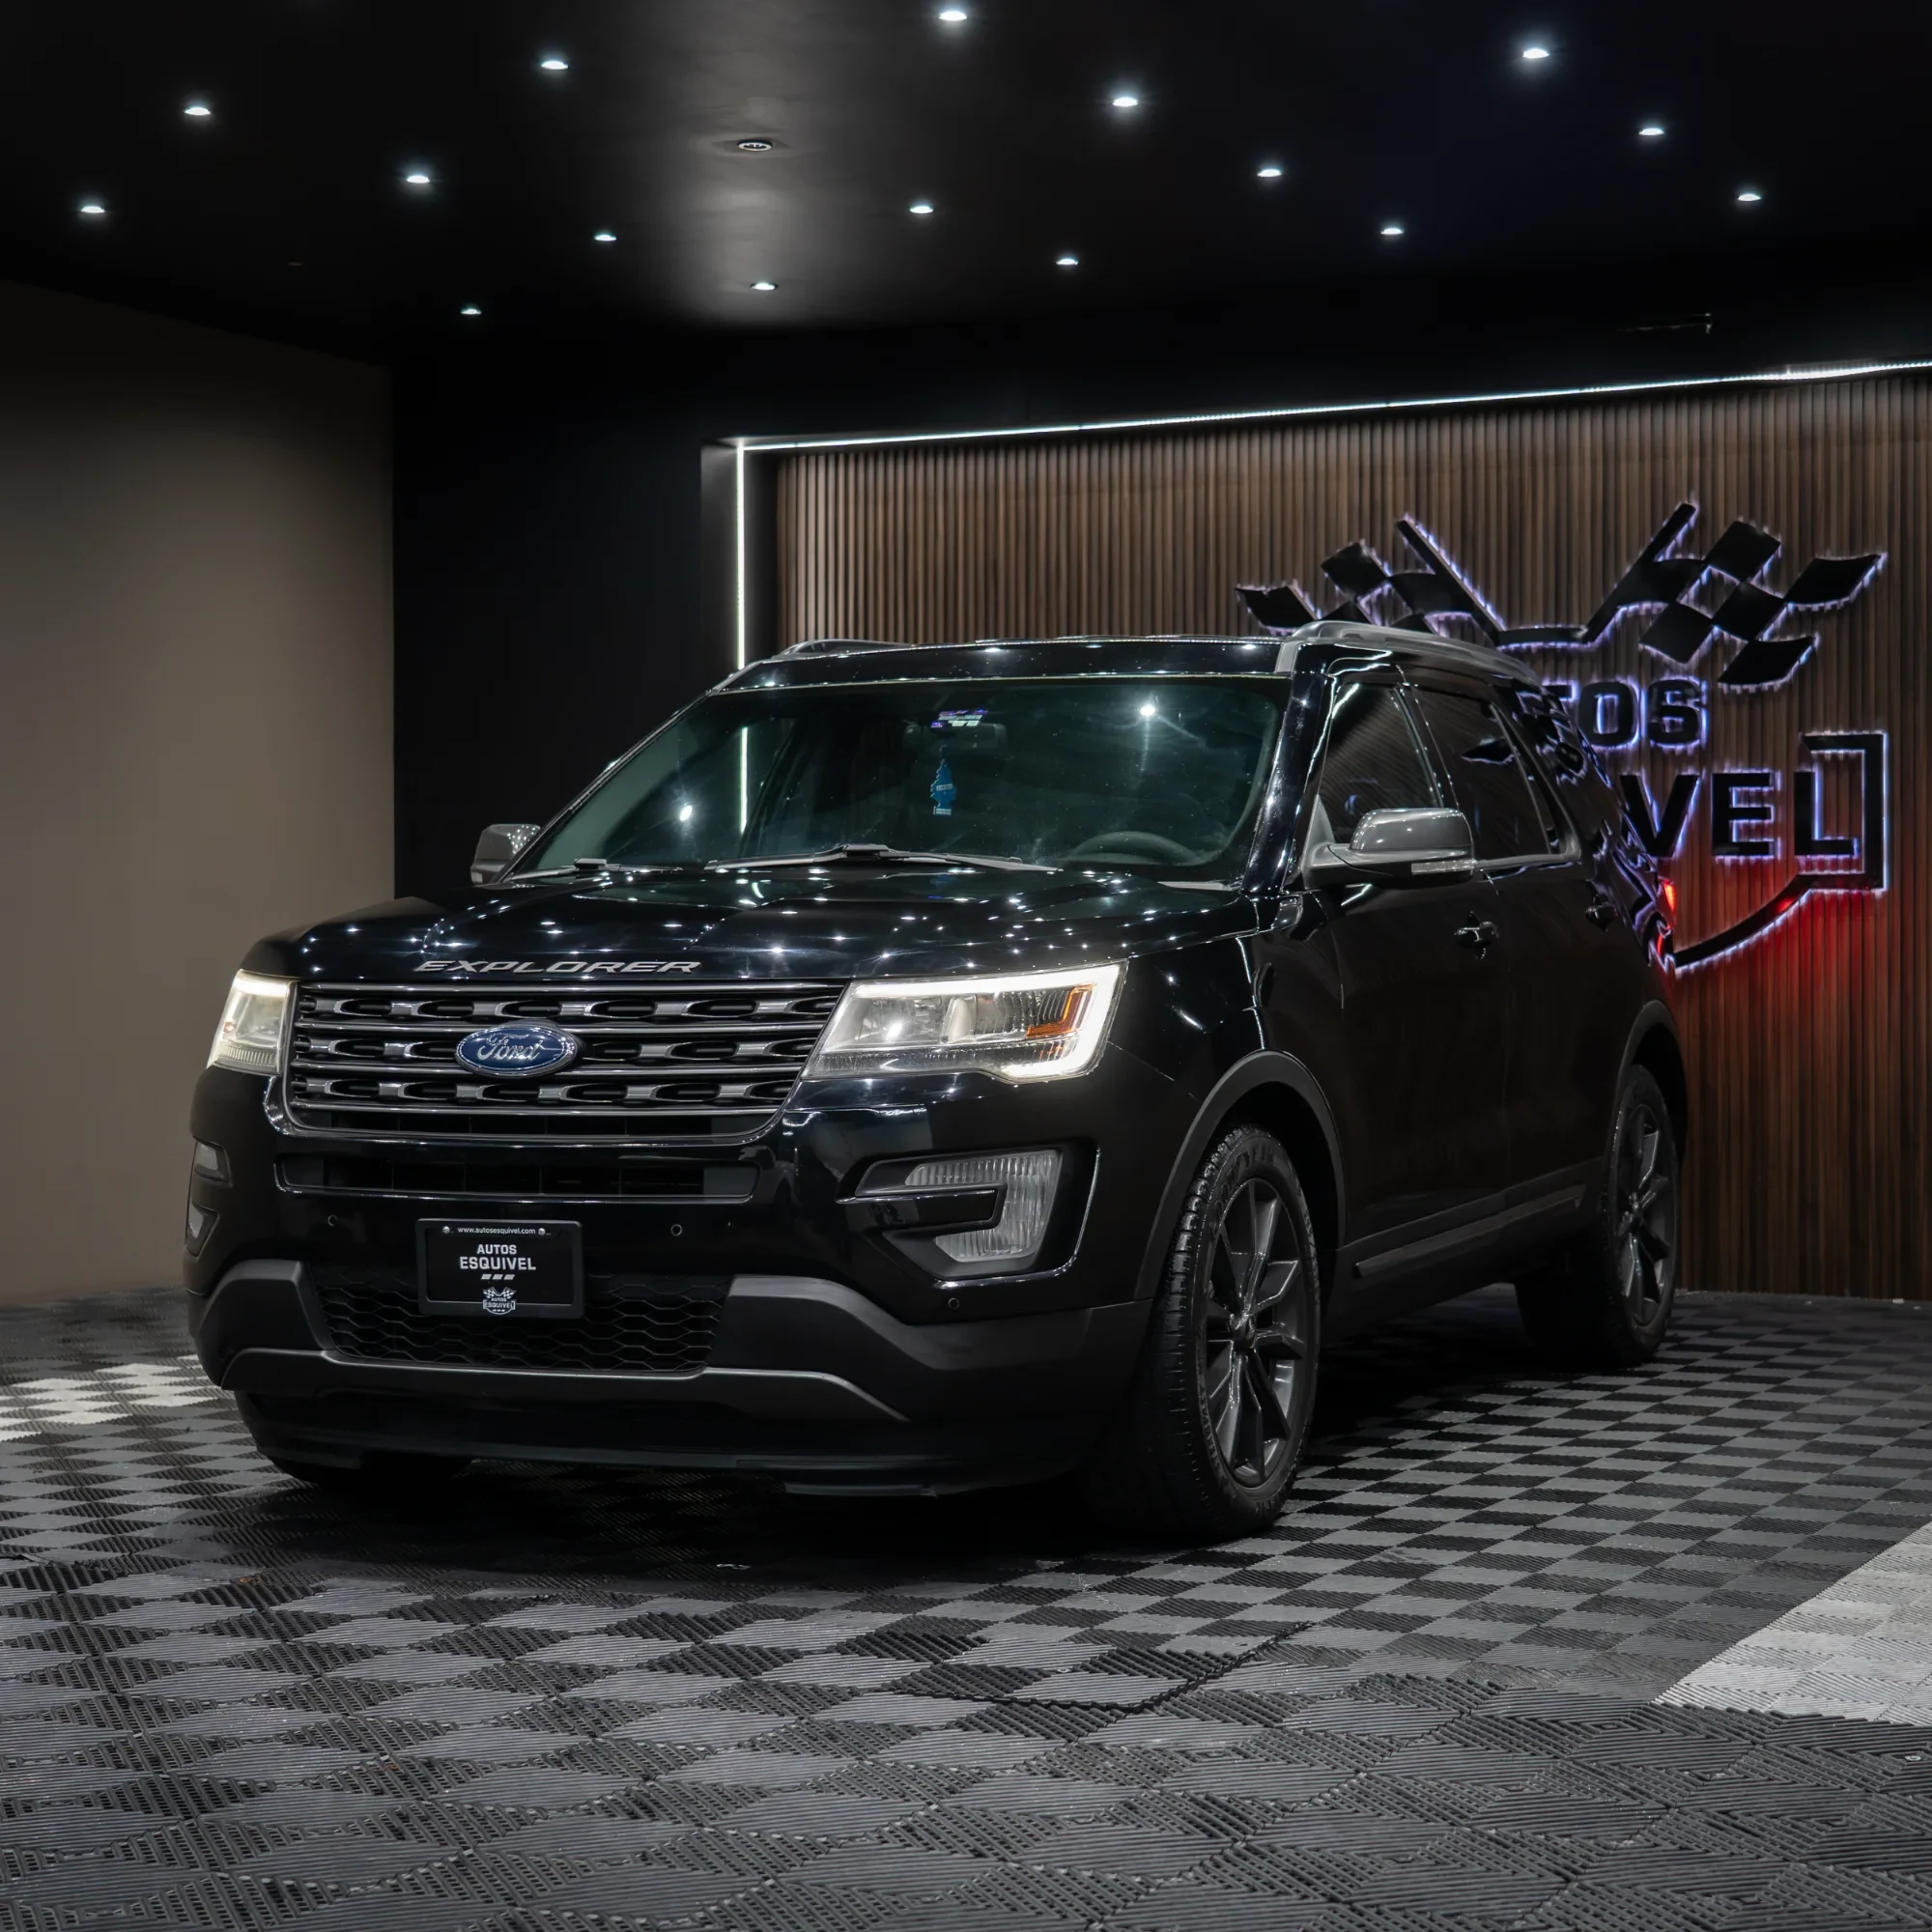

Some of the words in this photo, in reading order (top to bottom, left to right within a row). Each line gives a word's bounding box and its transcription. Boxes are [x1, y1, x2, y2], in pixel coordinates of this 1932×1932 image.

[413, 960, 701, 974] EXPLORER
[477, 1033, 547, 1061] Ford
[476, 1244, 517, 1255] AUTOS
[460, 1257, 536, 1270] ESQUIVEL
